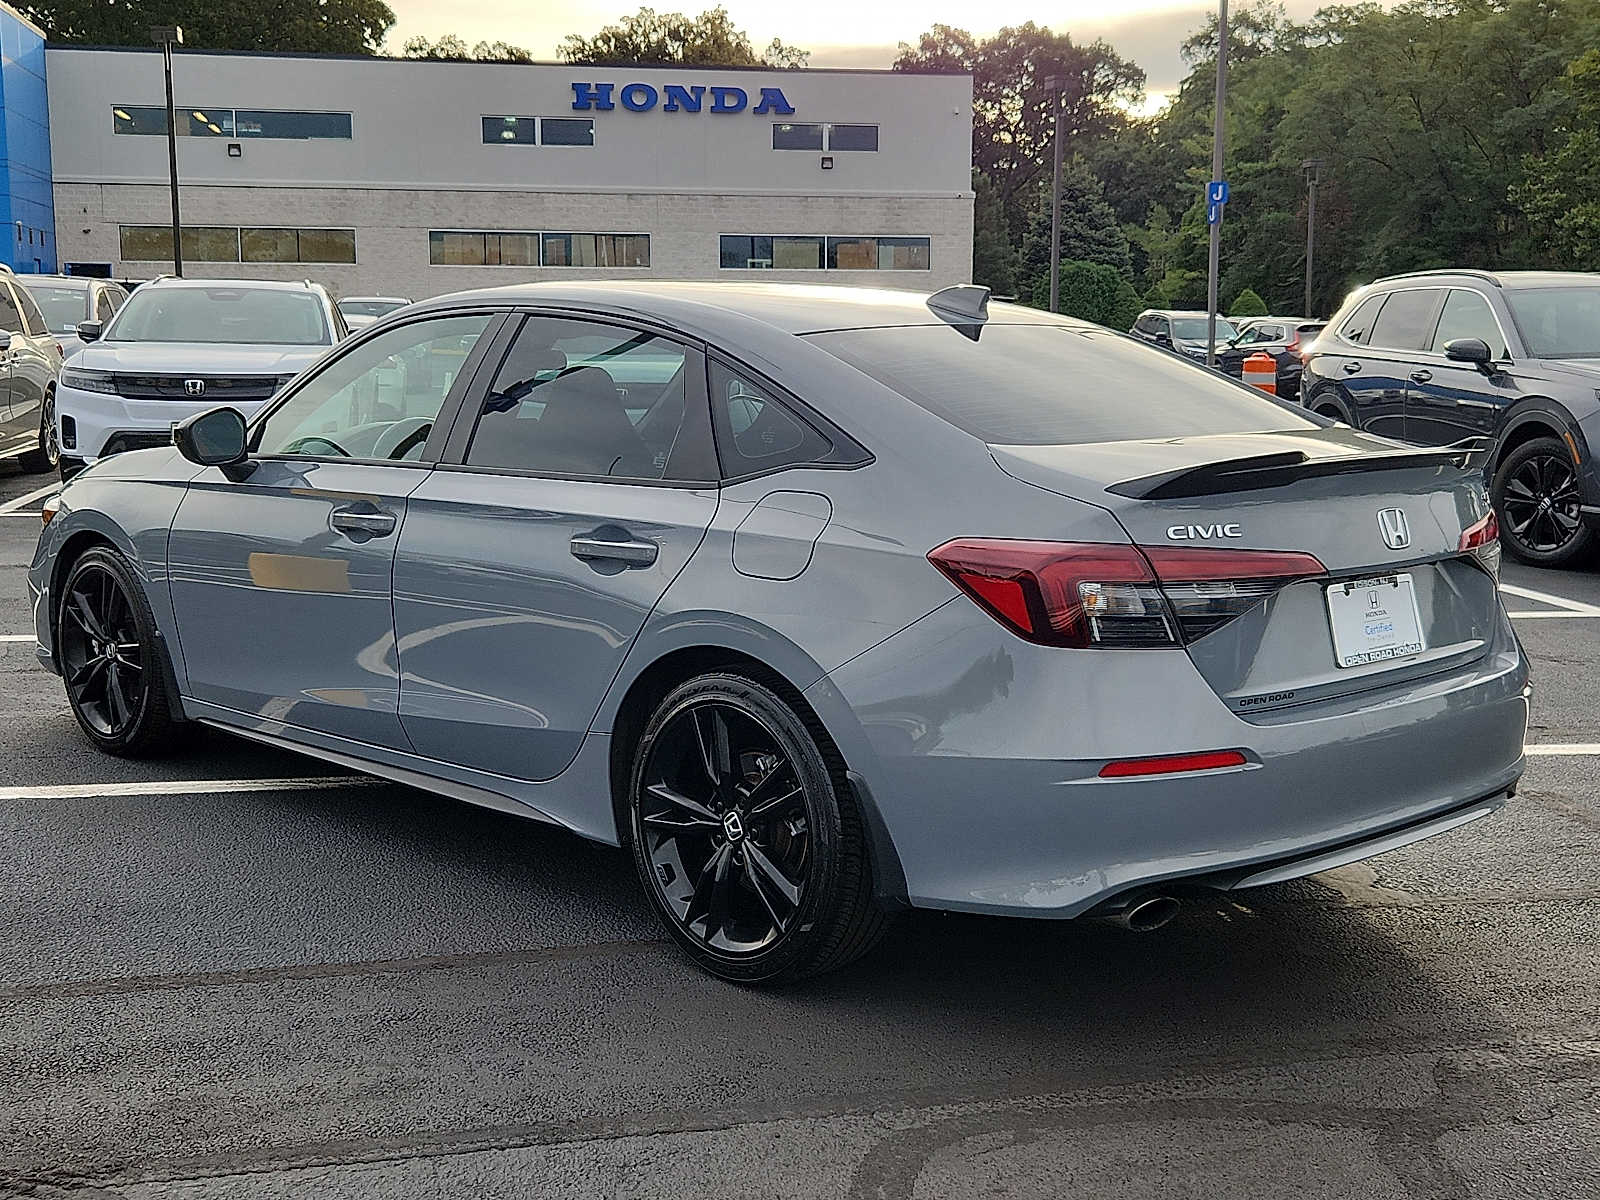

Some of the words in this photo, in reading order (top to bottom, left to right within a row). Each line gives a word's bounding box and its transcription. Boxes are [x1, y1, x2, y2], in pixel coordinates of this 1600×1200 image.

[571, 82, 796, 115] HONDA
[1212, 184, 1224, 201] J
[1208, 205, 1216, 222] J
[1166, 523, 1243, 540] CIVIC
[1365, 609, 1388, 618] HONDA
[1345, 653, 1369, 666] OPEN
[1370, 649, 1393, 661] ROAD
[1393, 643, 1422, 657] HONDA
[1239, 696, 1267, 707] OPEN
[1268, 692, 1295, 702] ROAD
